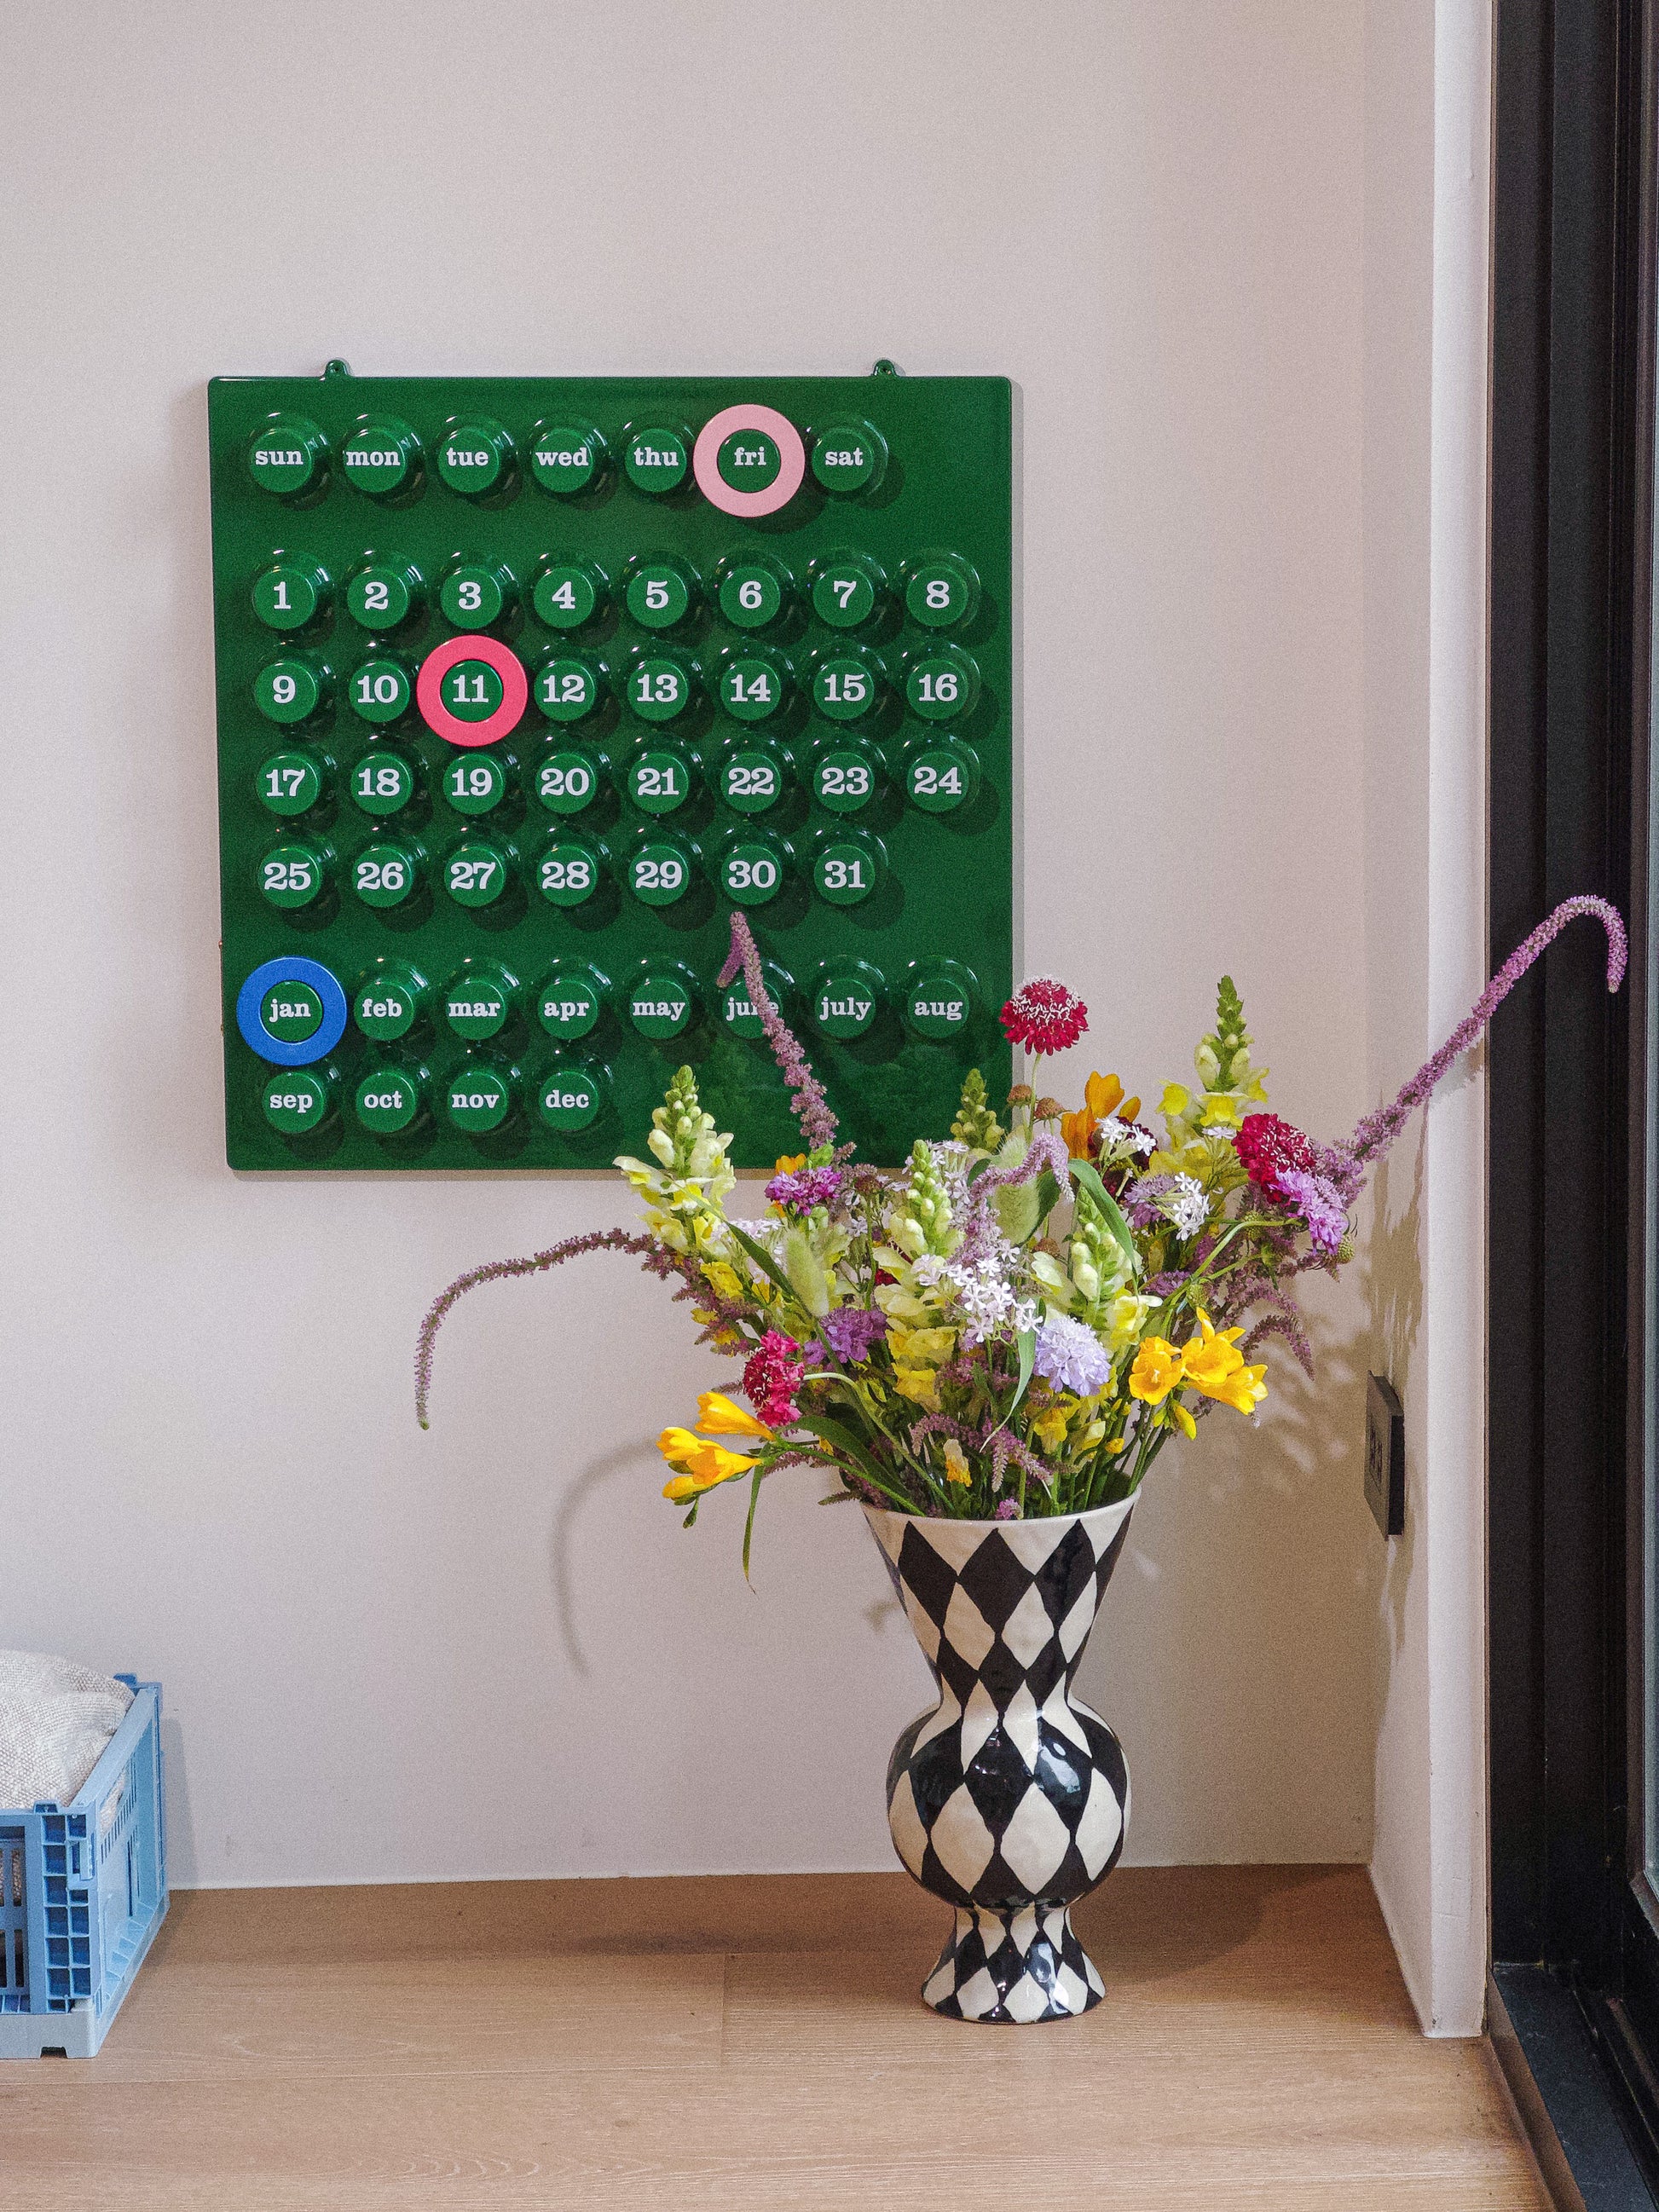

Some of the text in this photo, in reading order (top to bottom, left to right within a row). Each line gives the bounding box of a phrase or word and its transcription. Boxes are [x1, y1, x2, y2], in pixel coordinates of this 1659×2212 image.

[256, 447, 863, 466] sun mon tue wed thu fri sat
[274, 580, 949, 609] 1 2 3 4 5 6 7 8
[273, 674, 957, 703] 9 10 11 12 13 14 15 16
[266, 767, 962, 796] 17 18 19 20 21 22 23 24
[264, 861, 865, 890] 25 26 27 28 29 30 31
[269, 999, 310, 1022] jan
[362, 998, 402, 1017] feb
[448, 1002, 500, 1017] mar
[545, 1002, 589, 1021] apr
[633, 1002, 685, 1020] may
[819, 996, 871, 1020] july
[915, 1002, 962, 1020] aug
[270, 1090, 589, 1112] sep oct nov dec
